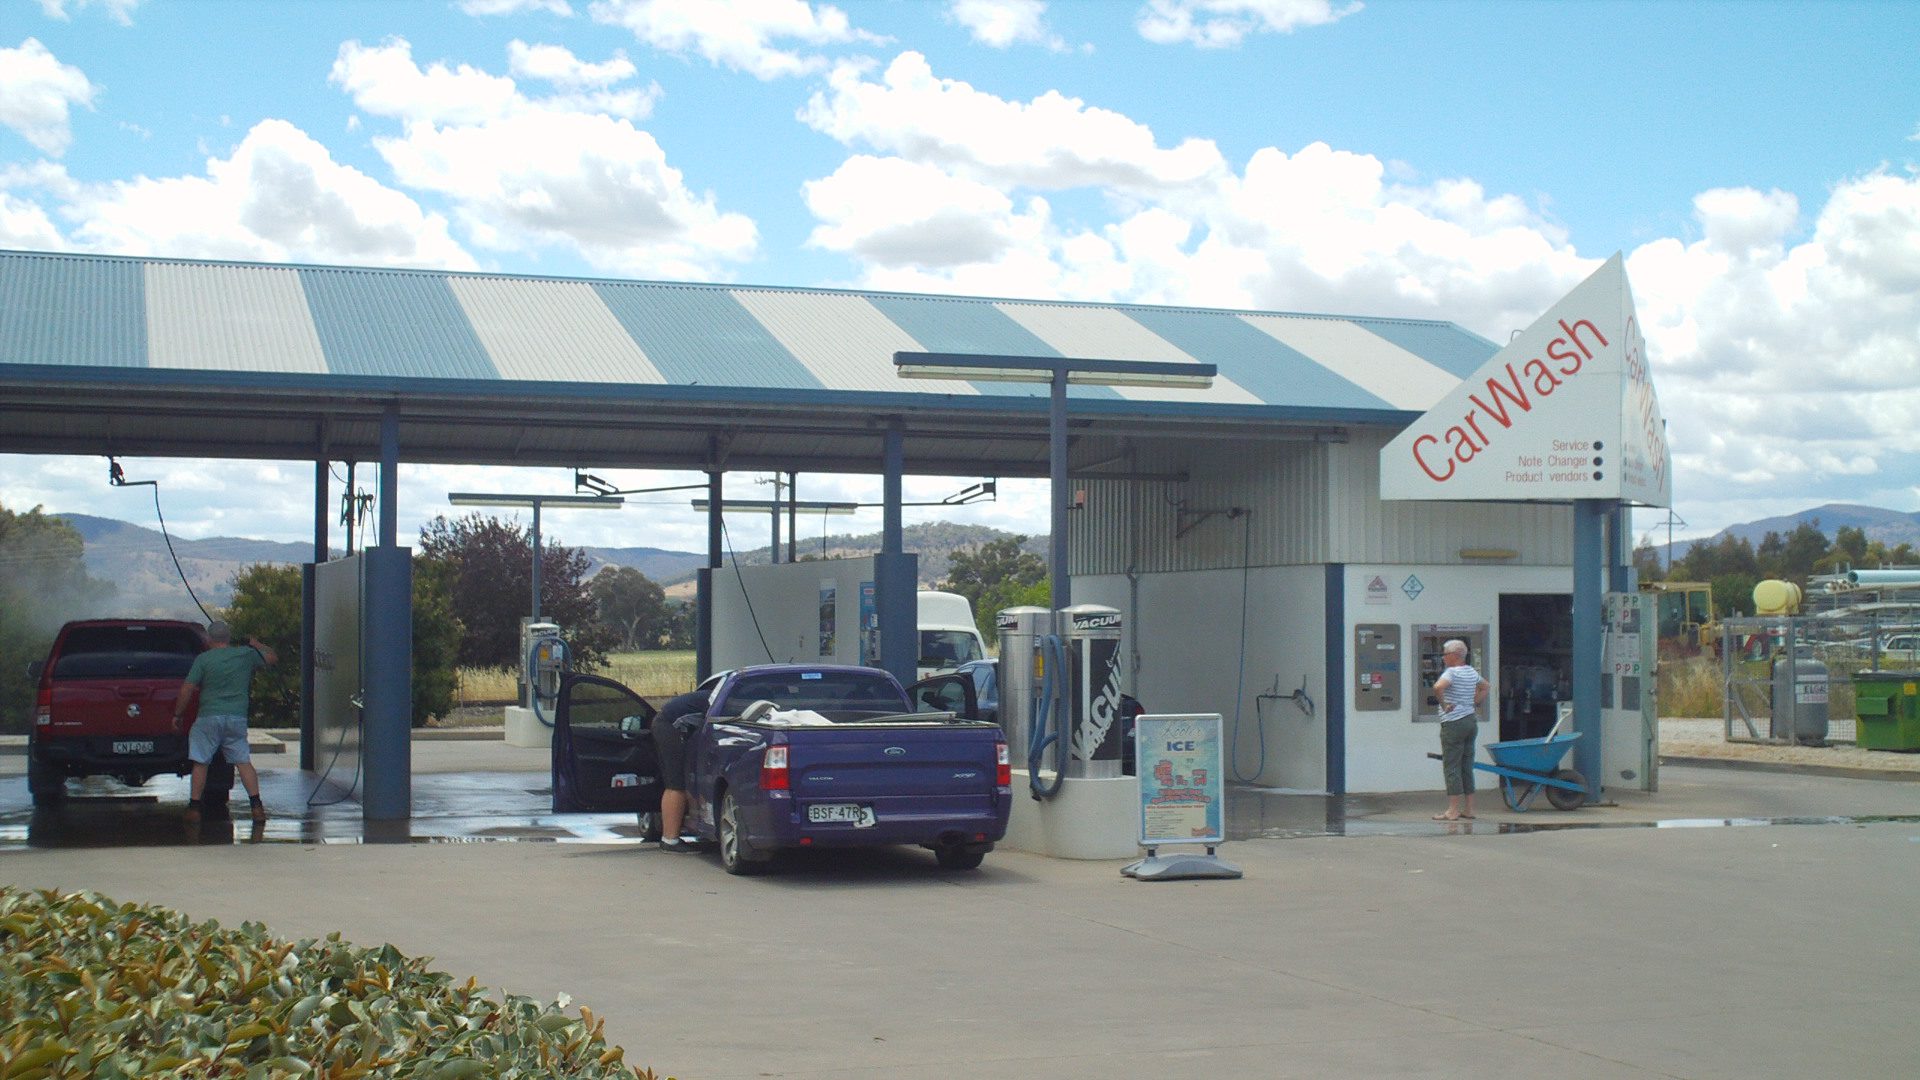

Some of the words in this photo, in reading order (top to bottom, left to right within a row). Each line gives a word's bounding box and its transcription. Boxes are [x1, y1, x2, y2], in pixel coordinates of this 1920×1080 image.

[1412, 318, 1609, 482] CarWash
[1552, 440, 1589, 451] Service
[1518, 456, 1543, 467] Note
[1548, 456, 1588, 468] Changer
[1505, 471, 1543, 482] Product
[1550, 471, 1589, 482] vendors
[1166, 741, 1195, 751] ICE
